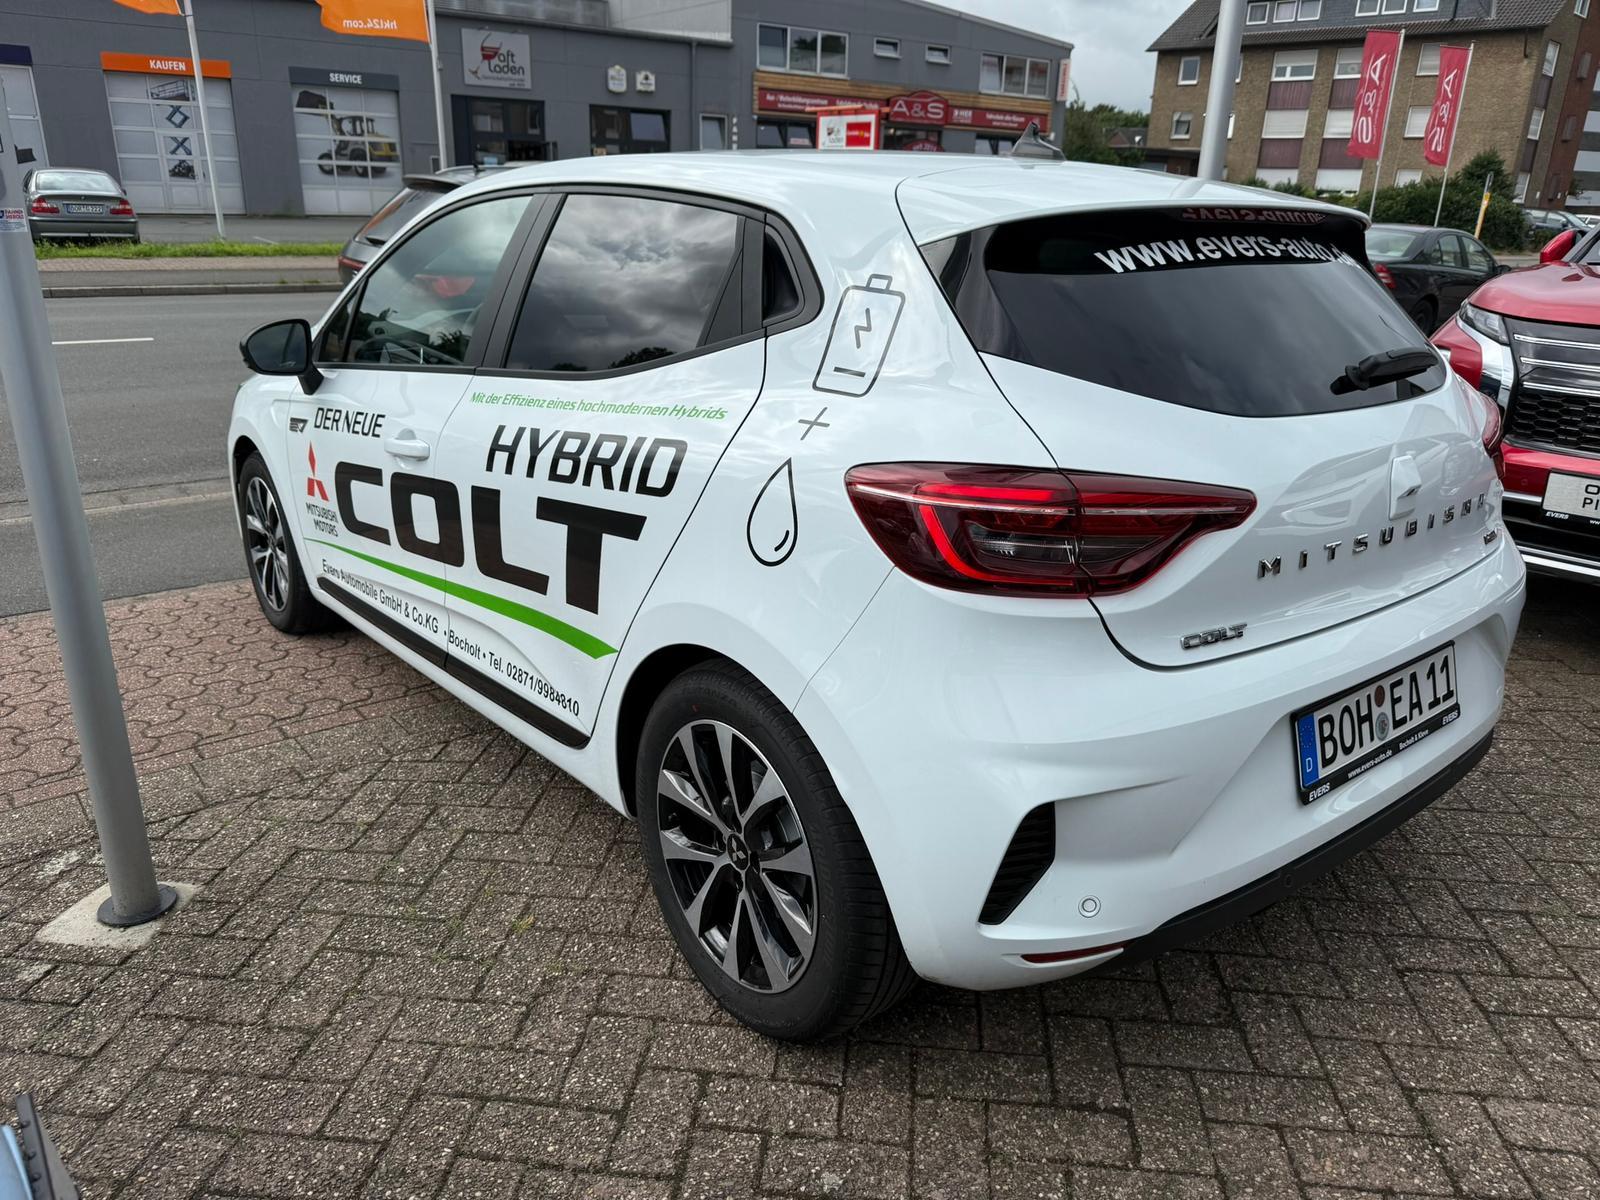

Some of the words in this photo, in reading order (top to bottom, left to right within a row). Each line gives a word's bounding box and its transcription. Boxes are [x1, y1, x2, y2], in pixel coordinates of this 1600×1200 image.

[149, 59, 186, 72] KAUFEN
[329, 72, 363, 85] SERVICE
[471, 391, 485, 404] Mit
[485, 393, 502, 404] der
[502, 393, 547, 409] Effizienz
[546, 397, 577, 411] eines
[576, 399, 670, 417] hochmodernen
[668, 404, 729, 420] Hybrids
[314, 407, 342, 432] DER
[342, 410, 386, 438] NEUE
[485, 424, 688, 498] HYBRID
[306, 502, 339, 523] MITSUBISHI
[1545, 511, 1570, 520] EVERS
[313, 519, 339, 537] MOTORS
[335, 461, 647, 615] COLT
[1257, 493, 1485, 580] MITSUBISHI
[322, 559, 340, 579] Evers
[340, 569, 378, 600] Automobile
[379, 589, 402, 614] GmbH
[404, 602, 410, 618] &
[411, 606, 439, 634] Co.KG
[449, 629, 481, 660] Bocholt
[488, 651, 504, 673] Tel.
[506, 662, 580, 717] 02871/9984810
[1179, 622, 1248, 650] COLT
[1317, 693, 1375, 769] BOH
[1389, 671, 1423, 730] EA
[1426, 655, 1454, 710] 11
[1305, 757, 1313, 773] D
[1308, 782, 1331, 802] EVERS
[1348, 749, 1393, 779] www.evers-auto.de
[1442, 710, 1459, 726] EVERS
